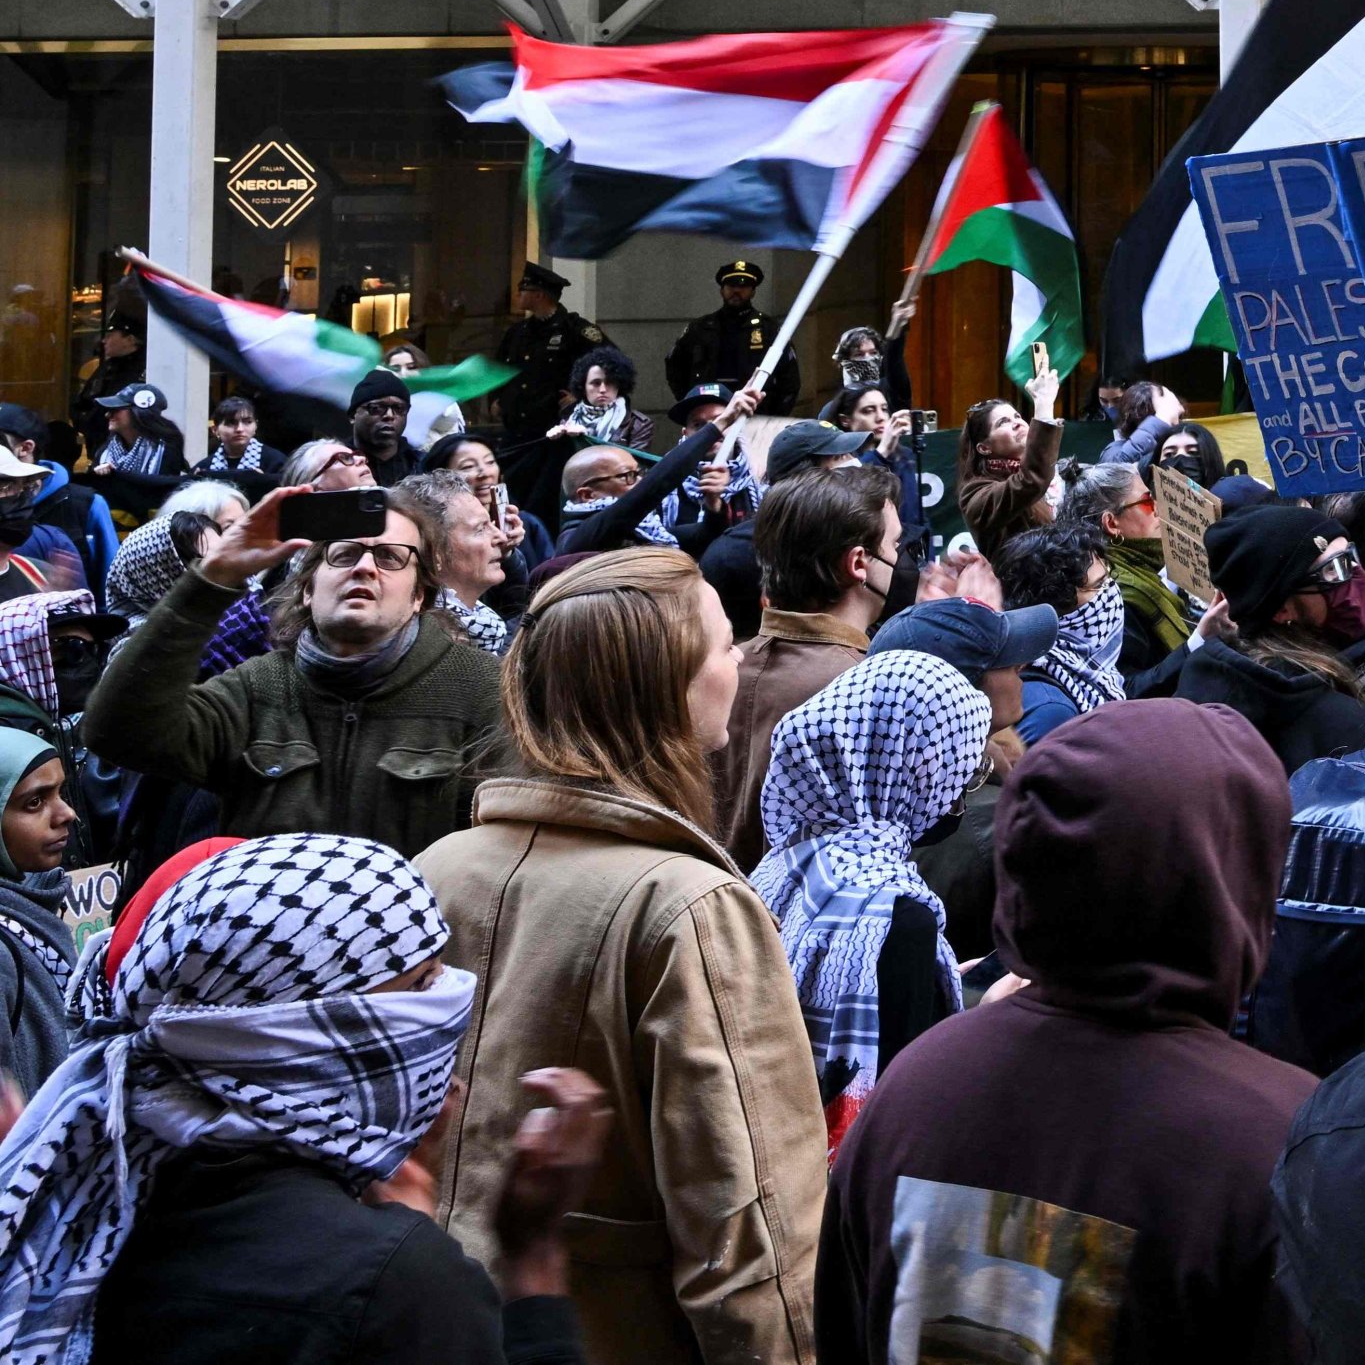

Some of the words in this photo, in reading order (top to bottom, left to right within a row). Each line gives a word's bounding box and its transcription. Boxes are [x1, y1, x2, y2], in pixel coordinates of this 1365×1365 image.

[236, 179, 308, 191] NEROLAB
[1245, 352, 1336, 401] THE
[1263, 409, 1293, 429] and
[1298, 400, 1353, 434] ALL
